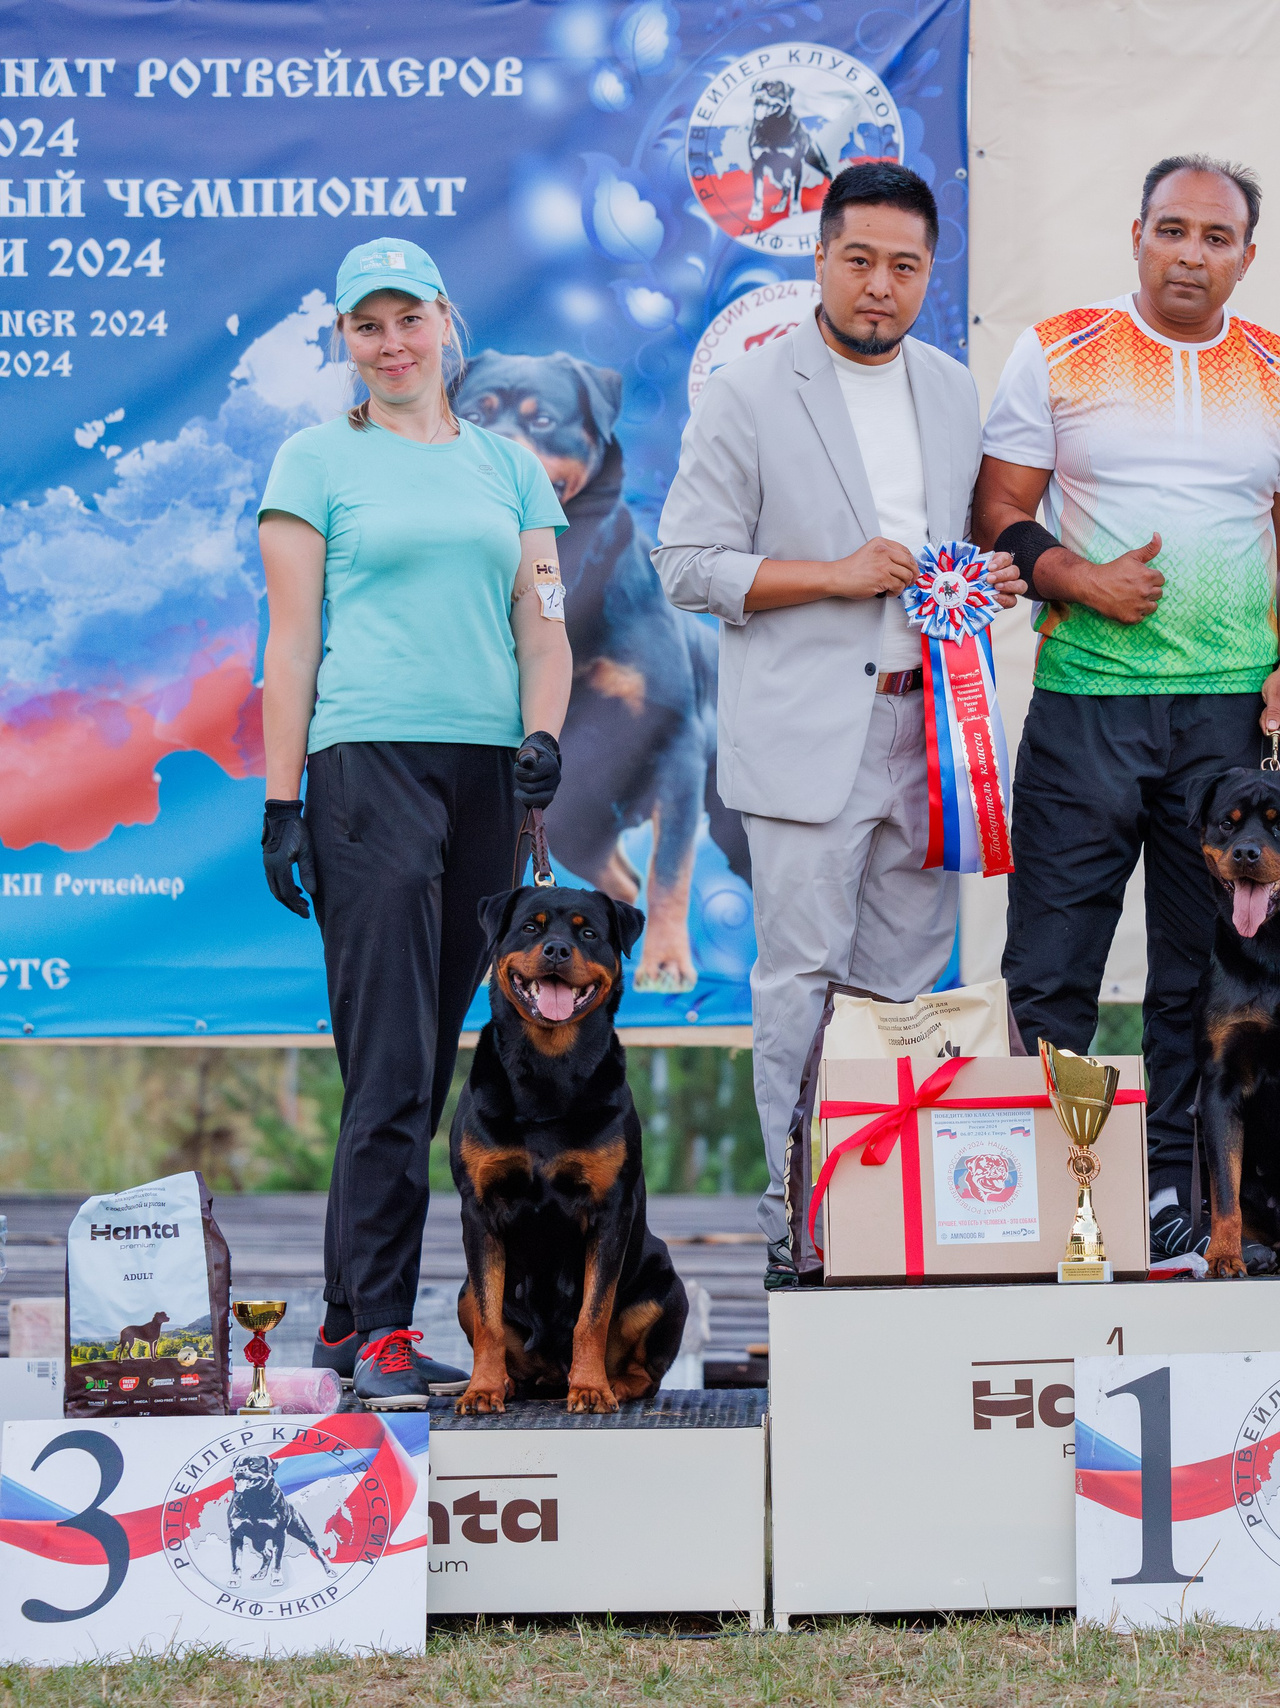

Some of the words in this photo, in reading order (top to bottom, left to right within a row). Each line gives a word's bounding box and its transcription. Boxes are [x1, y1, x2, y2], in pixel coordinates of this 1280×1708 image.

[0, 58, 116, 98] НАТ
[134, 48, 523, 98] РОТВЕЙЛЕРОВ
[789, 49, 859, 80] КЛУБ
[0, 118, 79, 157] 024
[0, 169, 86, 218] ЫЙ
[103, 176, 466, 218] ЧЕМПИОНАТ
[0, 238, 28, 277] И
[48, 238, 165, 277] 2024
[0, 310, 77, 337] NER
[90, 309, 168, 337] 2024
[693, 300, 750, 376] РОССИИ
[751, 283, 798, 306] 2024
[980, 731, 990, 775] класса
[982, 781, 1002, 861] Победитель
[0, 873, 43, 896] КП
[54, 872, 185, 901] Ротвейлер
[90, 1221, 180, 1241] Hanta
[123, 1272, 154, 1281] ADULT
[1105, 1367, 1203, 1585] 1
[165, 1430, 256, 1570] РОТВЕЙЛЕР
[271, 1426, 347, 1458] КЛУБ
[351, 1460, 386, 1567] РОССИИ
[21, 1430, 130, 1623] 3
[215, 1584, 341, 1617] РКФ-НКПР
